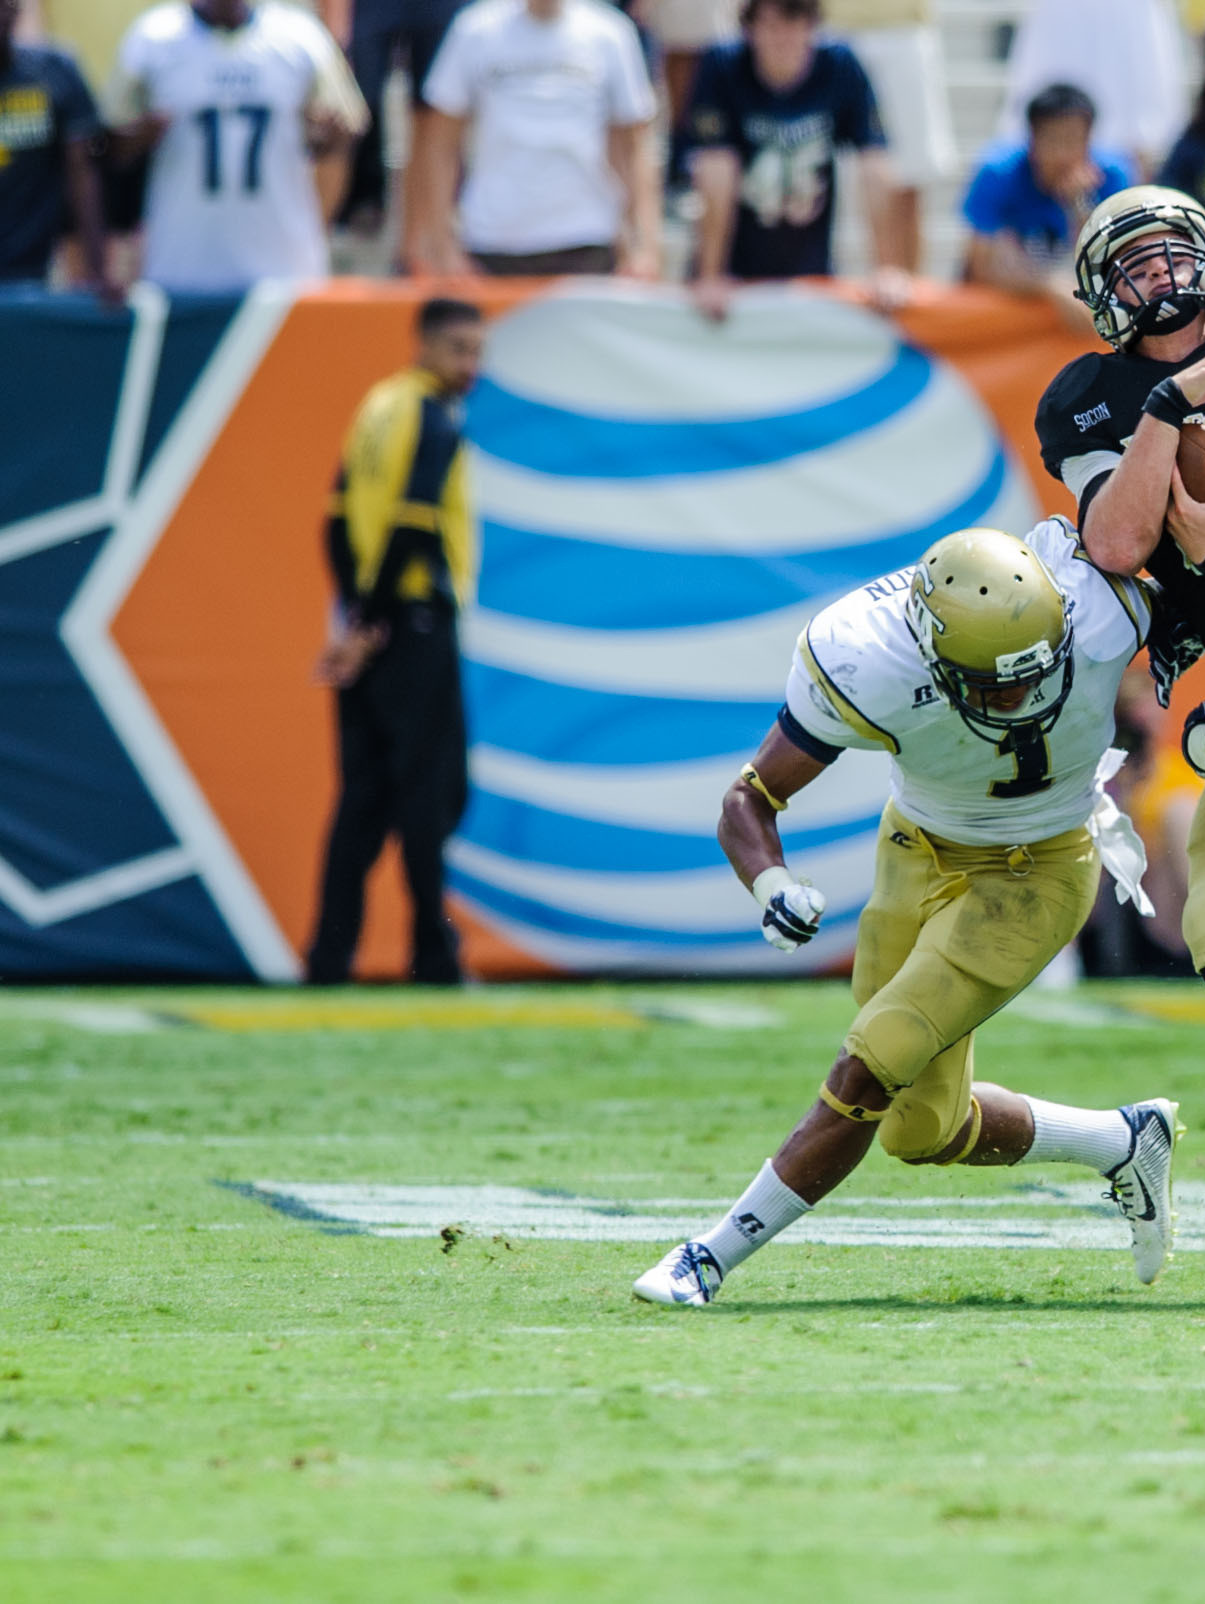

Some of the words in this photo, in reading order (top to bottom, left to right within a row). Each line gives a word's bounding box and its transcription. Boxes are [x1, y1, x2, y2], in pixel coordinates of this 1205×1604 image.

[196, 104, 272, 196] 17
[1073, 401, 1112, 433] SOCON
[986, 722, 1058, 798] 1
